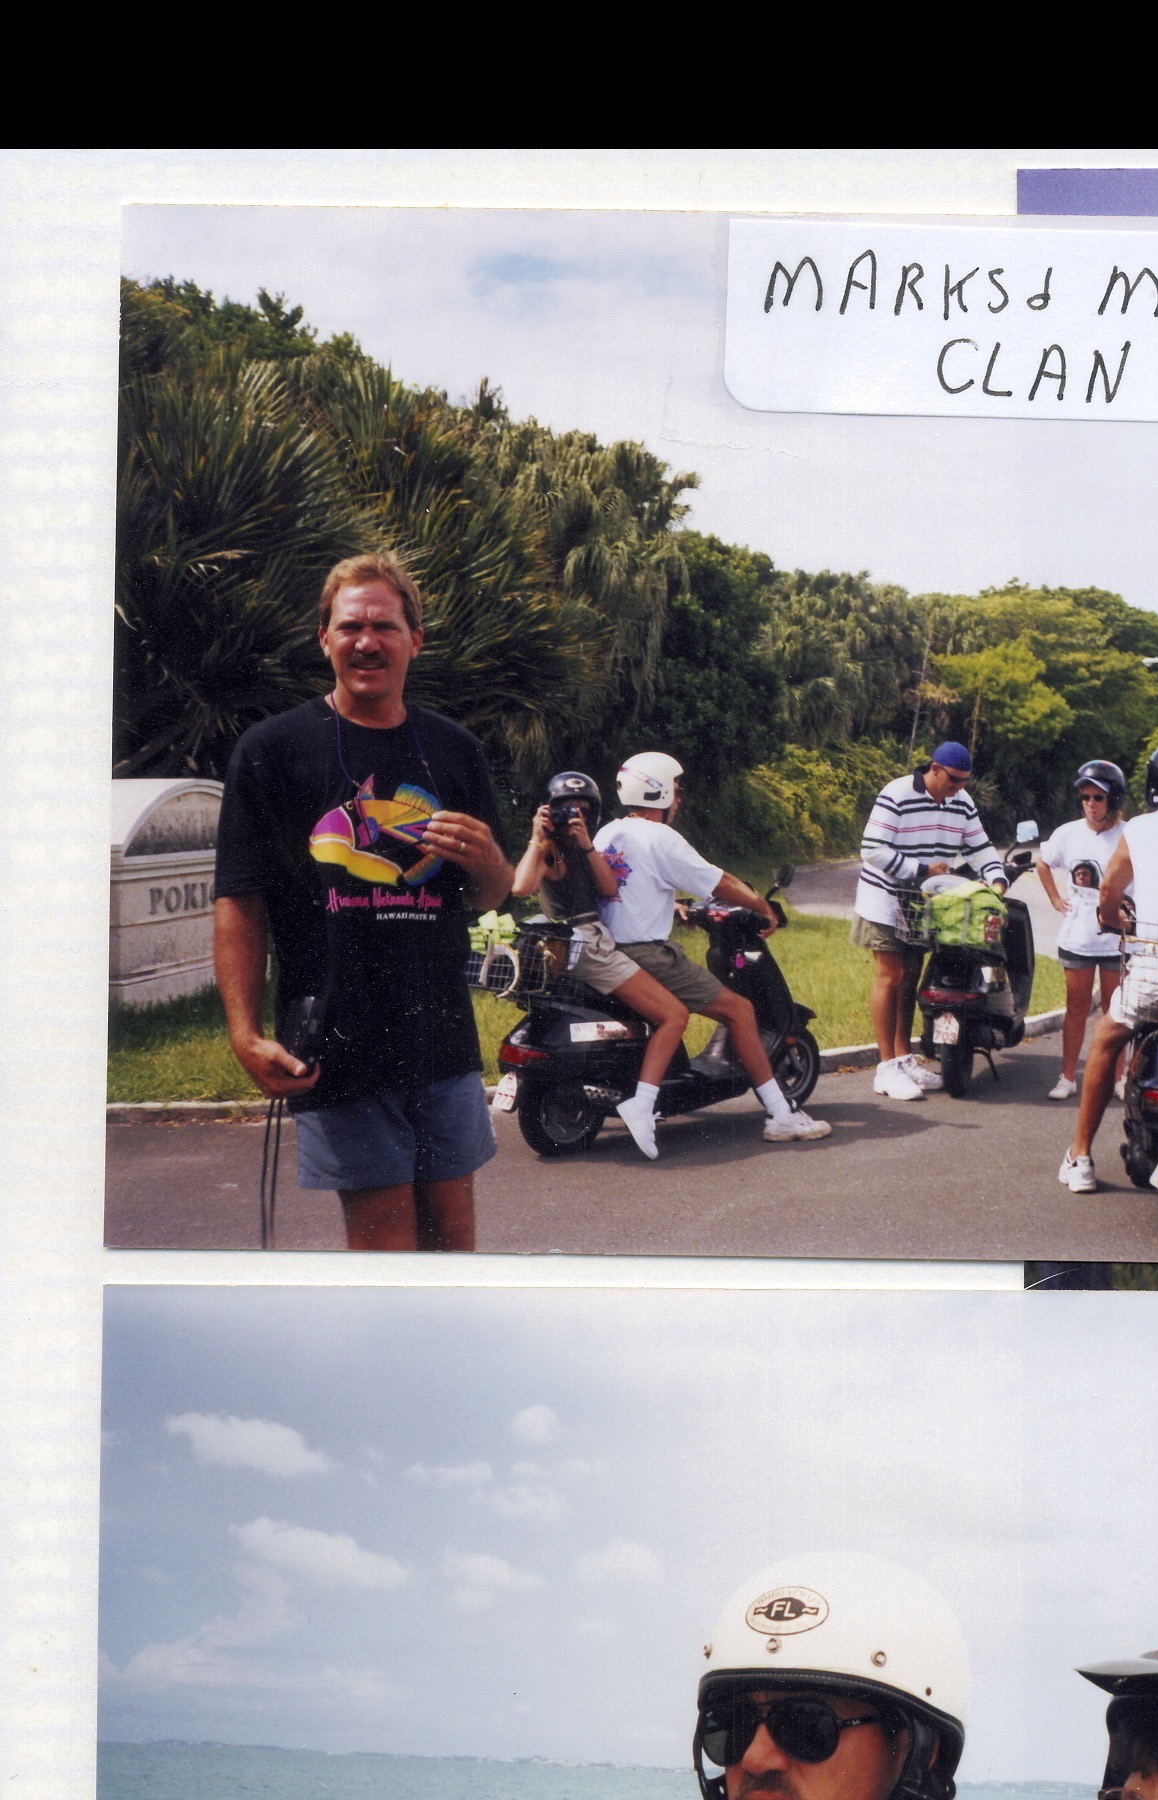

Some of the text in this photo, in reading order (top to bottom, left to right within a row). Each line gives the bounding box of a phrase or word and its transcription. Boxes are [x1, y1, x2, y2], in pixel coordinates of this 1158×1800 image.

[763, 249, 1009, 321] MARKS
[936, 337, 1132, 404] CLAN
[149, 881, 214, 915] POKI
[376, 912, 408, 920] HAWAII
[770, 1601, 796, 1618] FL
